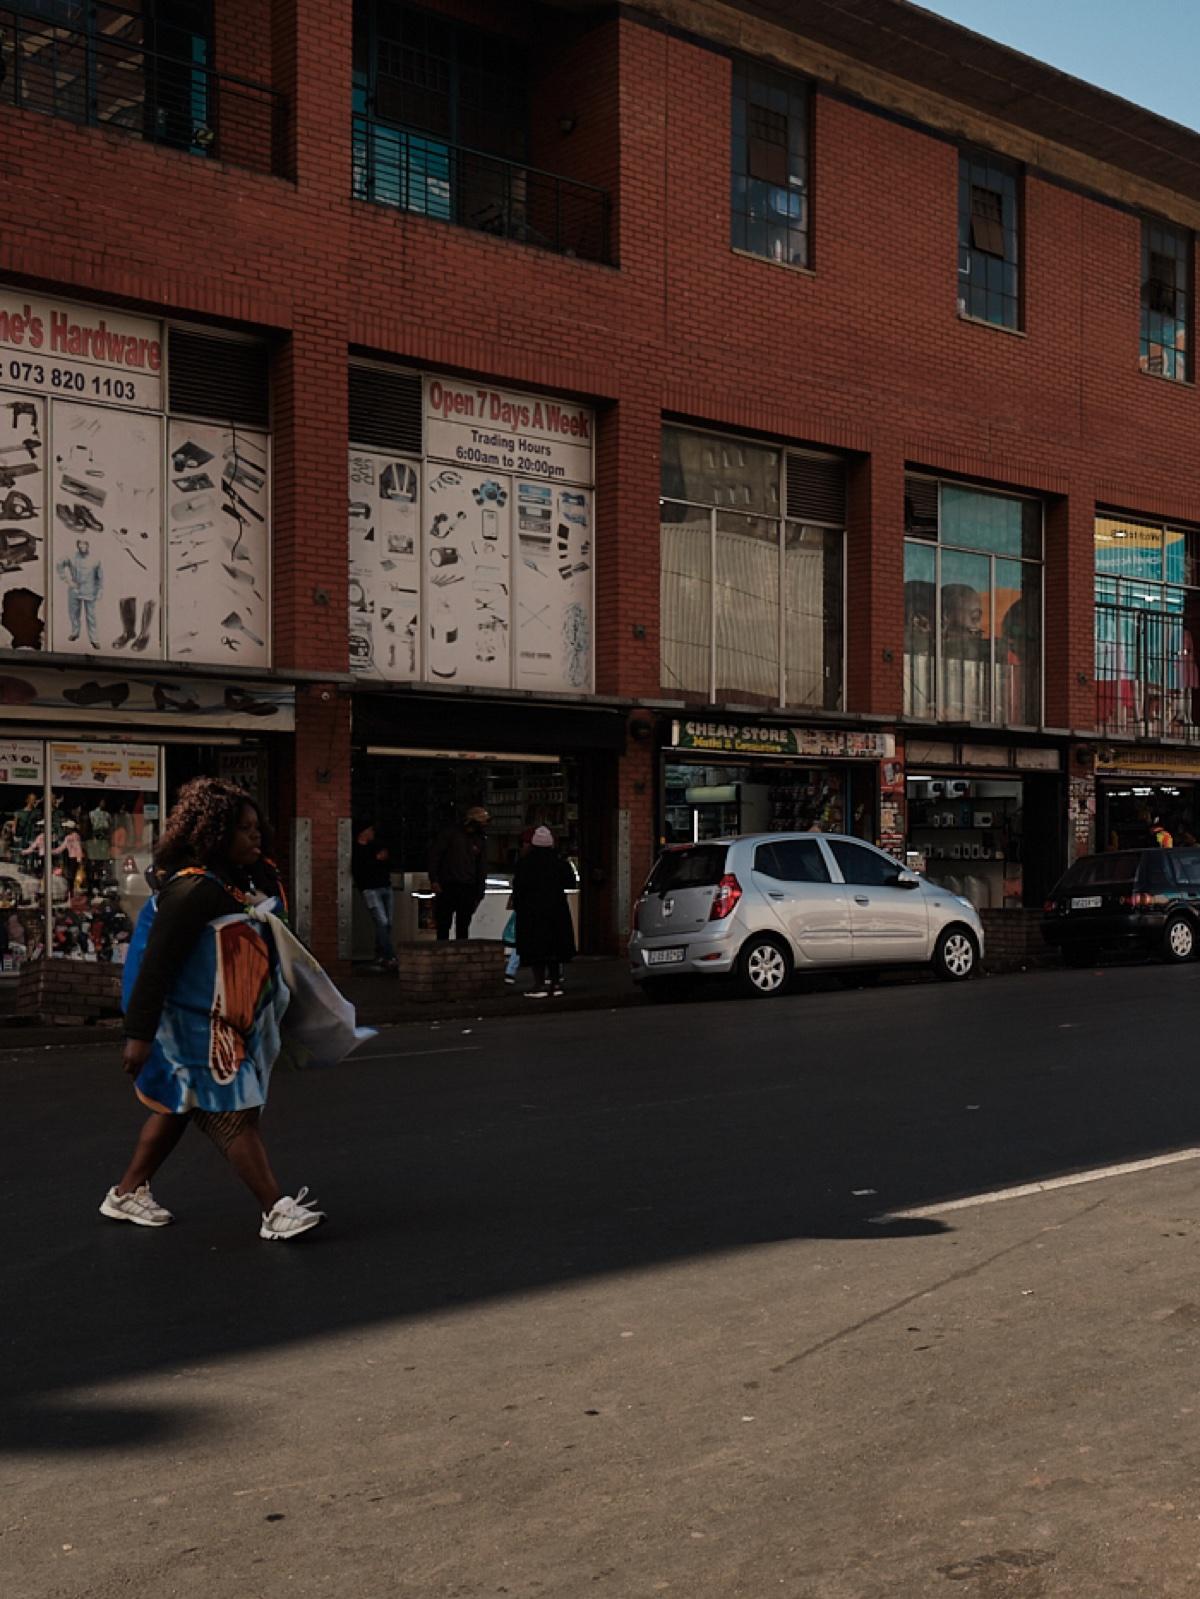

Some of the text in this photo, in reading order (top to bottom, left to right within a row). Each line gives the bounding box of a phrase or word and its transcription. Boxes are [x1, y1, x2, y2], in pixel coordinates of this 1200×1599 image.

[50, 310, 161, 370] Hardware
[10, 361, 44, 384] 073
[51, 369, 85, 391] 820
[92, 376, 135, 400] 1103
[430, 382, 589, 438] Open 7 Days A Week
[471, 430, 551, 456] Trading Hours
[456, 446, 565, 477] 6:00am to 20:00pm
[685, 721, 788, 742] CHEAP STORE
